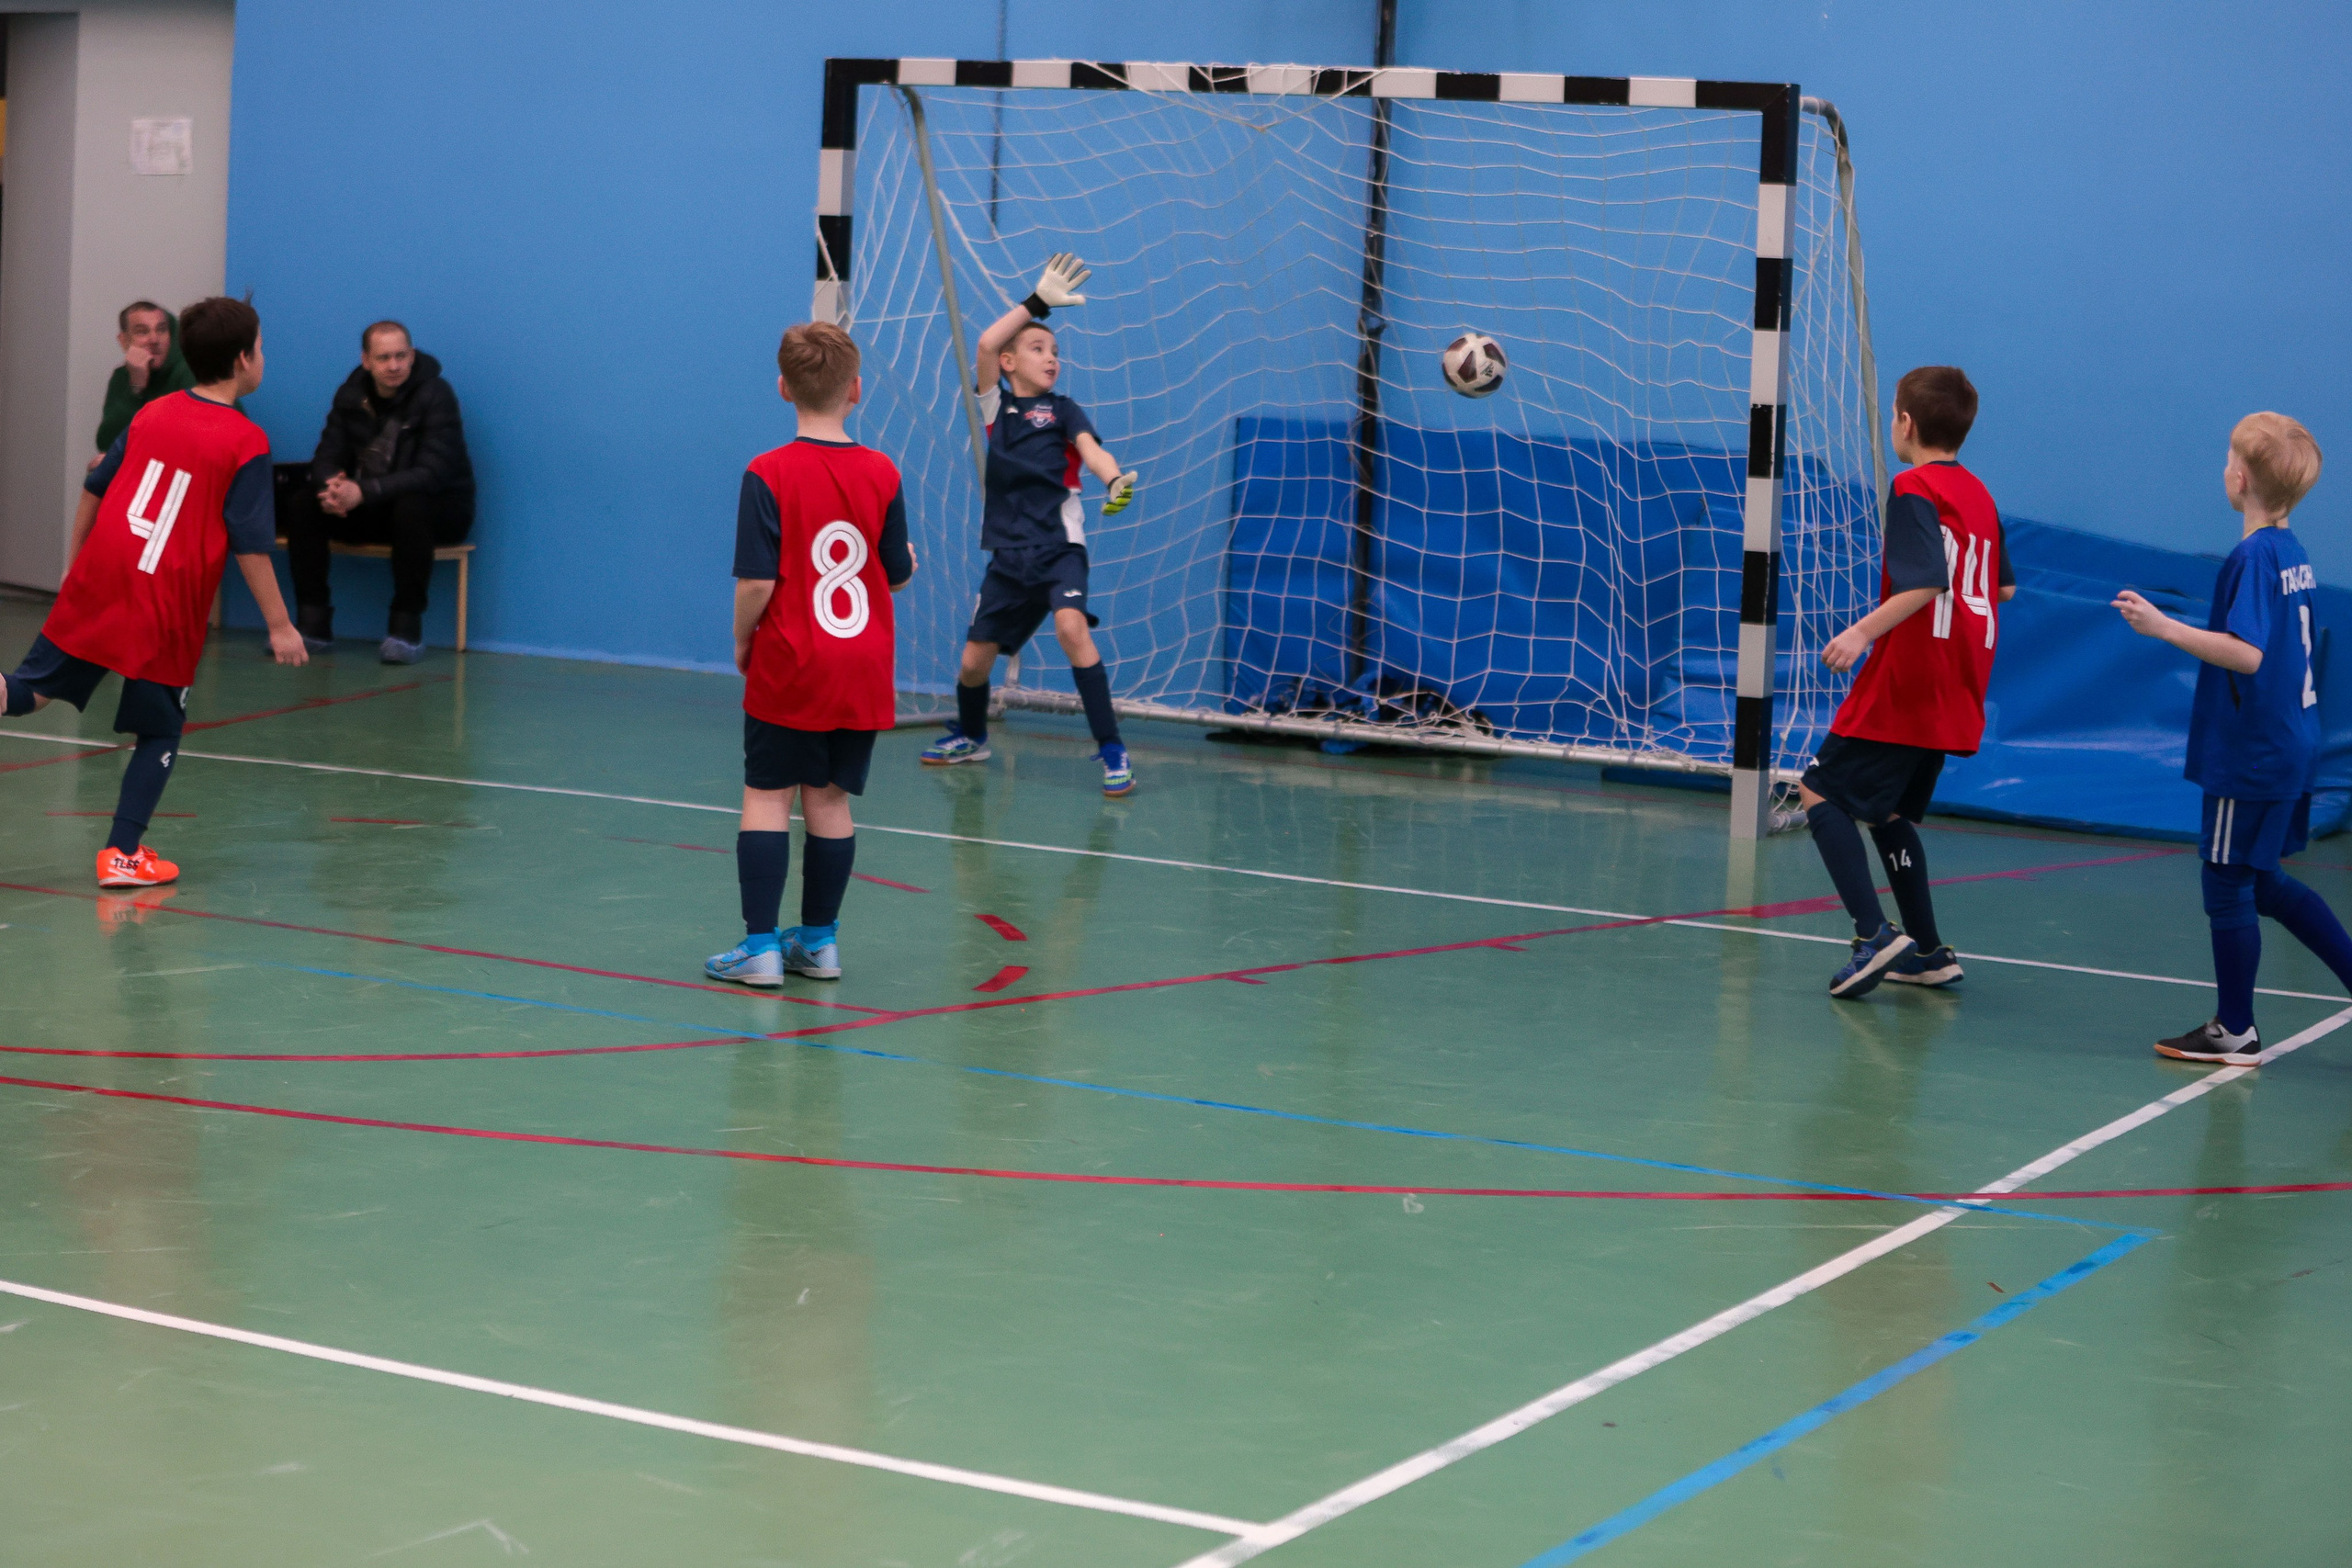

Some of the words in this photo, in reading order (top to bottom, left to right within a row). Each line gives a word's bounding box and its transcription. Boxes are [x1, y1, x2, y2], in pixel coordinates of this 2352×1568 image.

[127, 457, 192, 575] 4
[811, 520, 869, 638] 8
[1933, 525, 1995, 649] 14
[1889, 849, 1912, 872] 14
